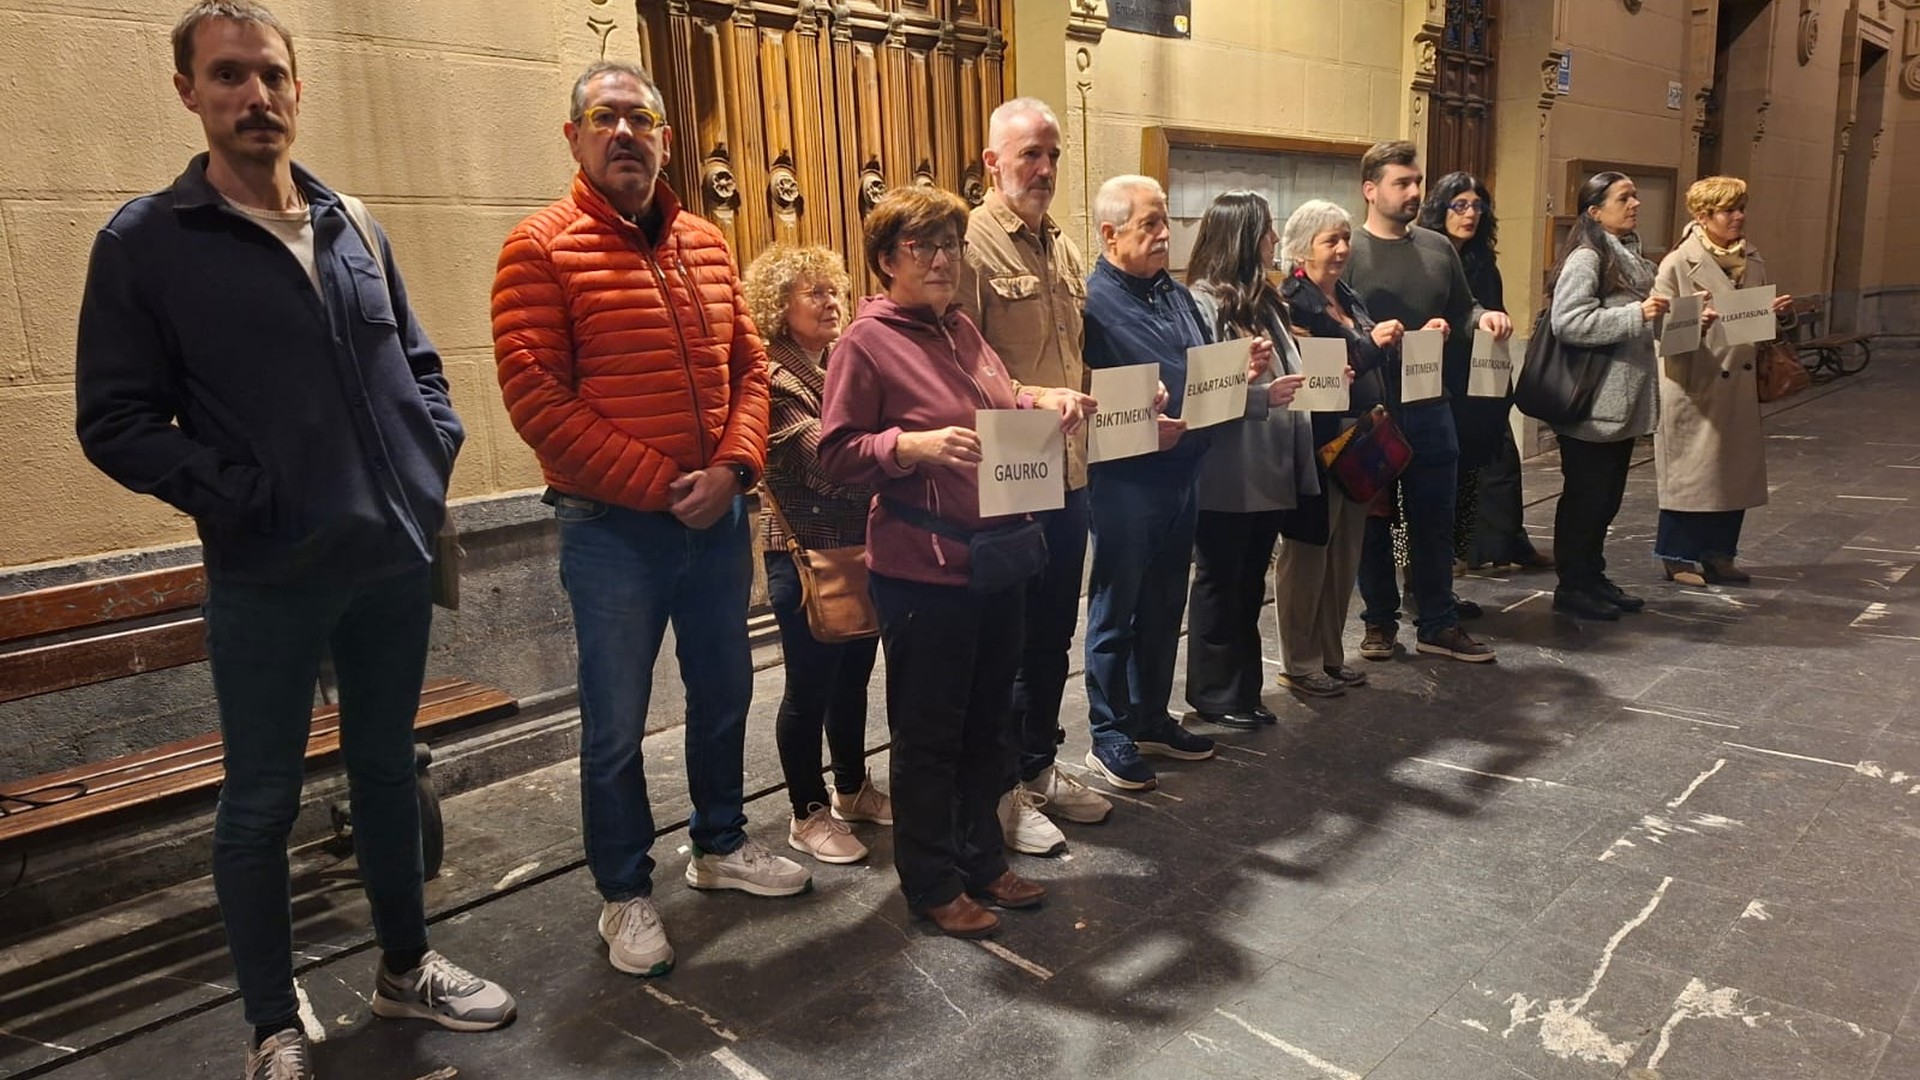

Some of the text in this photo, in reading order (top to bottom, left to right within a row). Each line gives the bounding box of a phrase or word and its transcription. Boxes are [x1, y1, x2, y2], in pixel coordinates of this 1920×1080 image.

[1187, 372, 1247, 397] ELKARTASUNA
[1309, 376, 1341, 389] GAURKO
[1095, 406, 1153, 428] BIKTIMEKIN
[994, 461, 1049, 482] GAURKO
